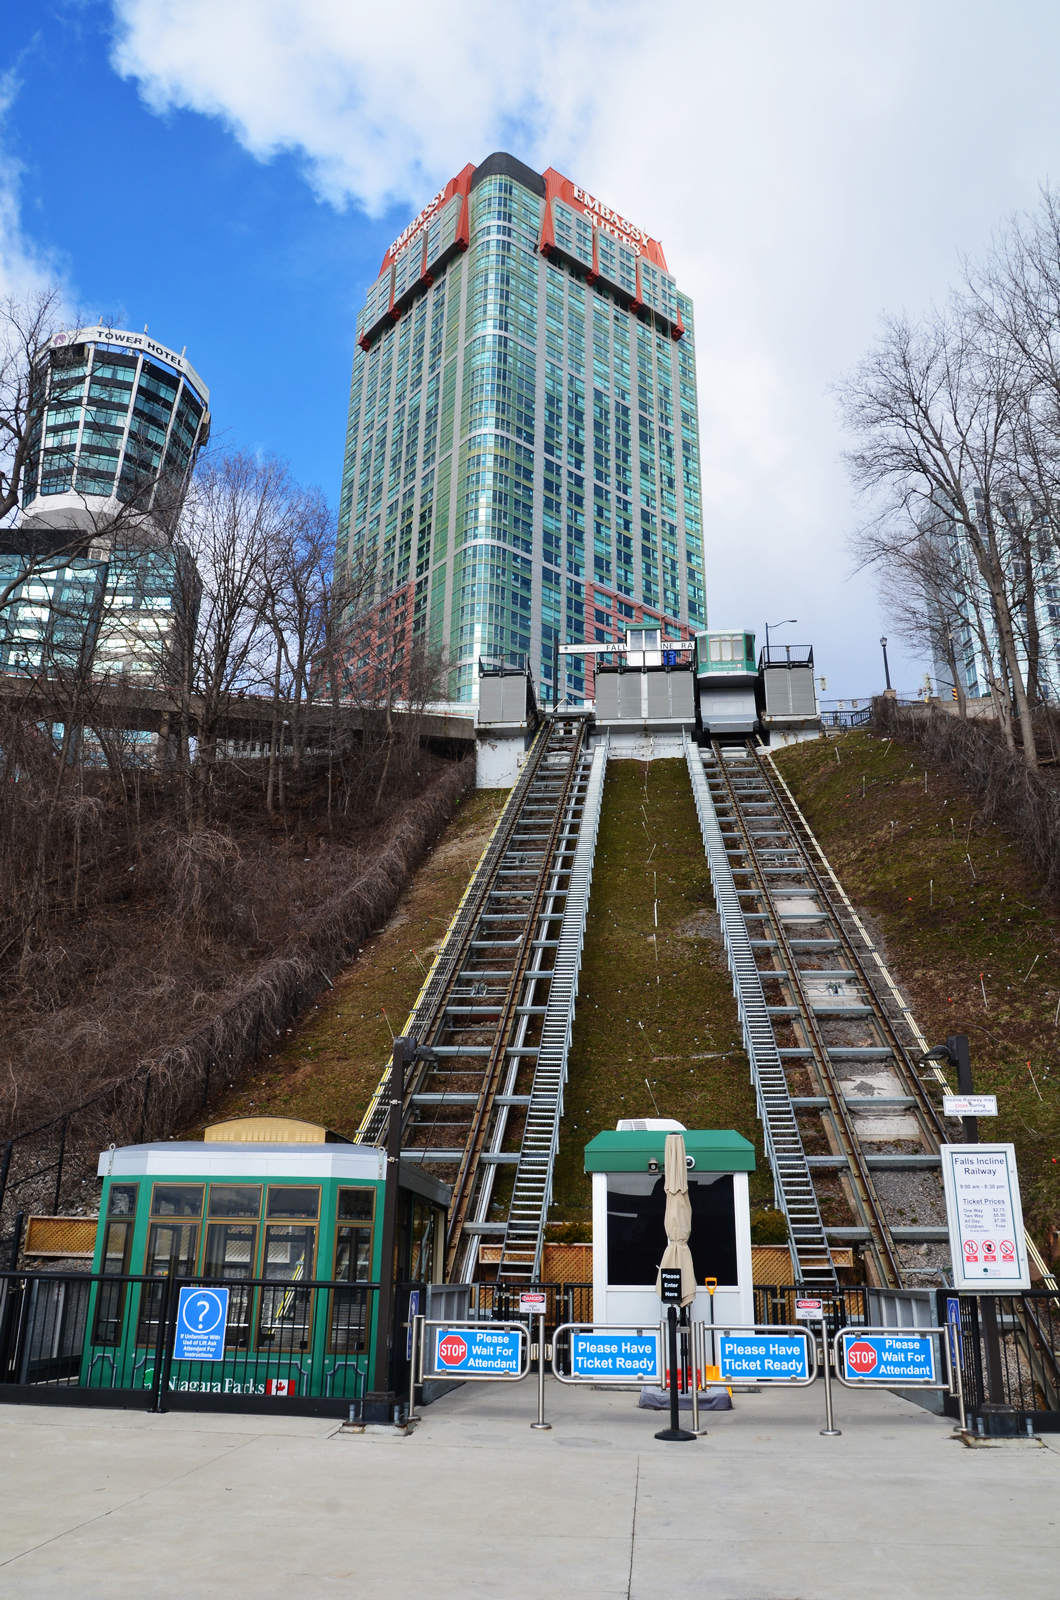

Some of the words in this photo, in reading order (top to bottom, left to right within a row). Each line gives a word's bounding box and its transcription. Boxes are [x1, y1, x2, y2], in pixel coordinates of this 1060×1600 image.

[389, 184, 447, 258] EMBASSY
[573, 185, 649, 248] EMBASSY
[97, 331, 143, 345] TOWER
[147, 341, 184, 368] HOTEL
[976, 1157, 1004, 1165] Incline
[964, 1167, 996, 1176] Railway
[477, 1334, 509, 1344] Please
[885, 1339, 920, 1349] Please
[441, 1344, 466, 1357] STOP
[472, 1346, 493, 1355] Wait
[496, 1347, 513, 1356] For
[578, 1342, 618, 1353] Please
[621, 1342, 652, 1354] Have
[725, 1344, 766, 1355] Please
[769, 1344, 800, 1355] Have
[849, 1351, 875, 1364] STOP
[881, 1352, 905, 1362] Wait
[908, 1353, 925, 1362] For
[467, 1358, 516, 1369] Attendant
[576, 1357, 613, 1368] Ticket
[616, 1357, 654, 1371] Ready
[724, 1359, 761, 1370] Ticket
[765, 1359, 803, 1373] Ready
[879, 1365, 930, 1375] Attendant
[169, 1376, 221, 1393] Niagara
[224, 1378, 265, 1394] Parks
